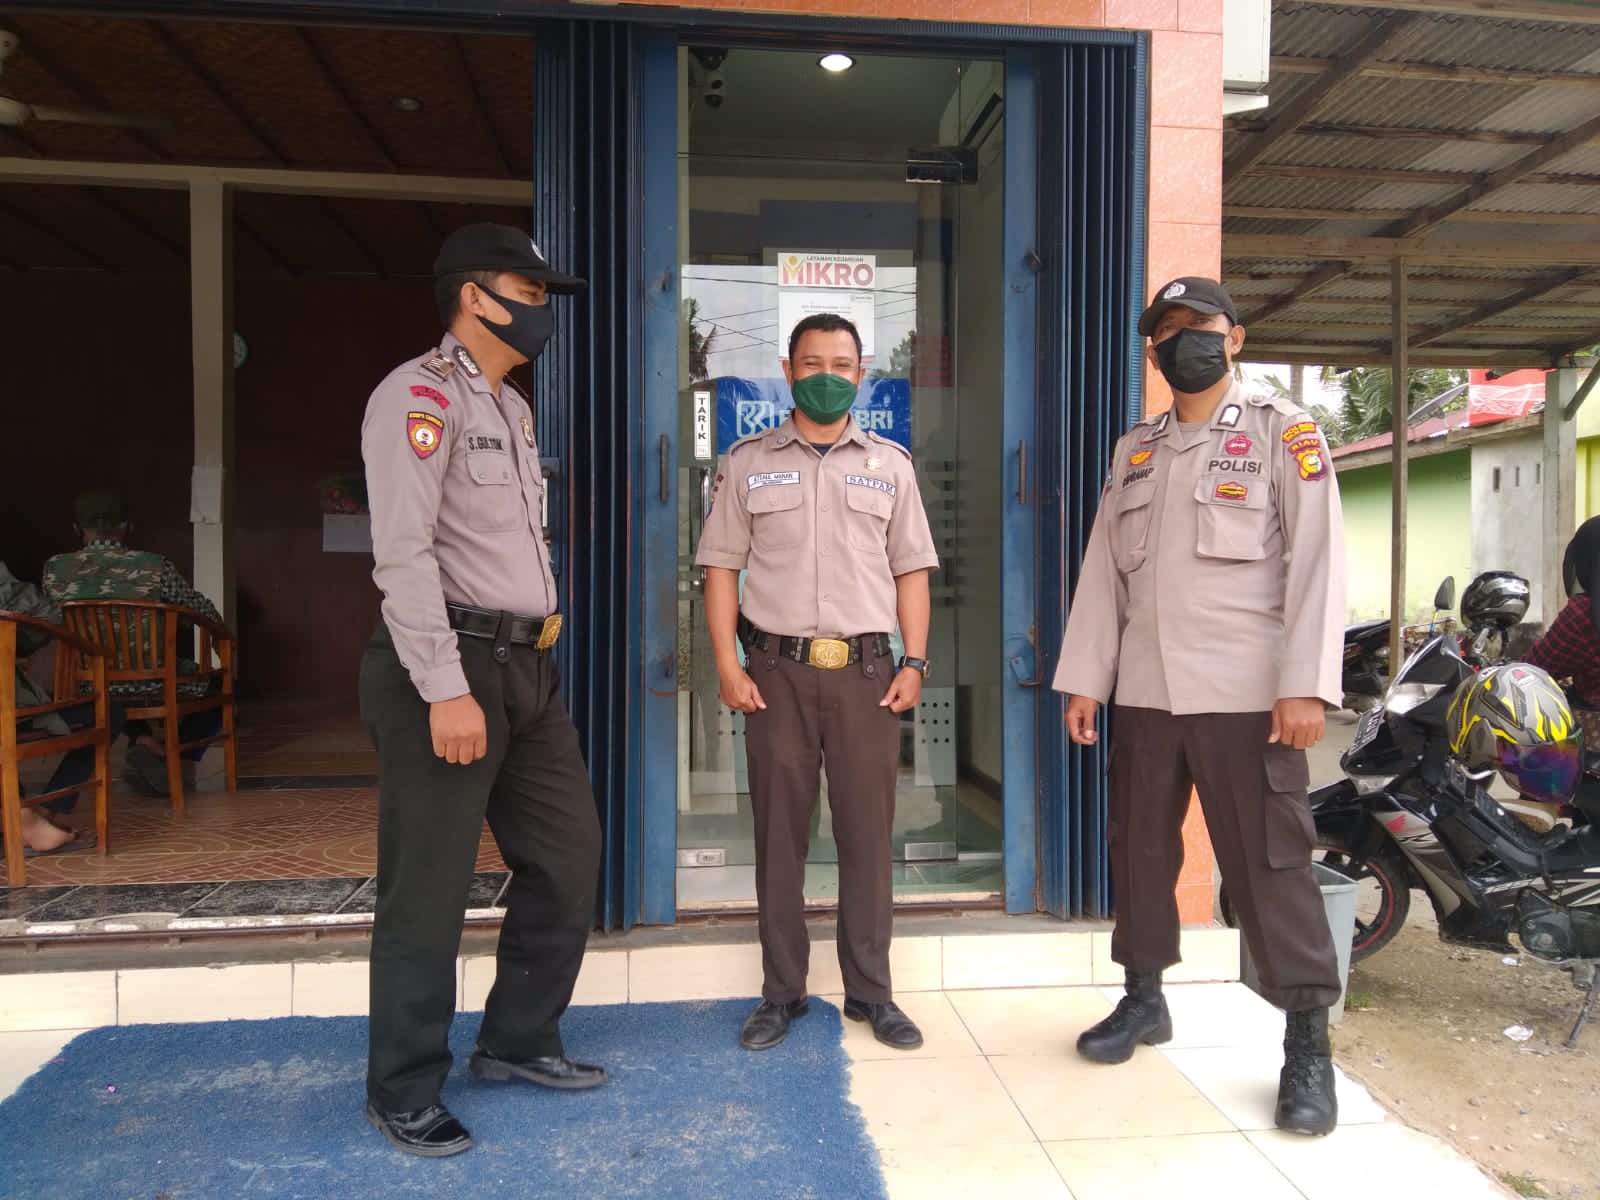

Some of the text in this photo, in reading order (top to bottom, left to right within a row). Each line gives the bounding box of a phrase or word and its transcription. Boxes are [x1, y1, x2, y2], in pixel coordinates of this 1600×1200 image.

[782, 260, 874, 286] MIKRO
[698, 397, 706, 440] TARIK
[855, 409, 893, 429] BRI
[1208, 460, 1262, 475] POLISI
[850, 476, 894, 493] SATPAM
